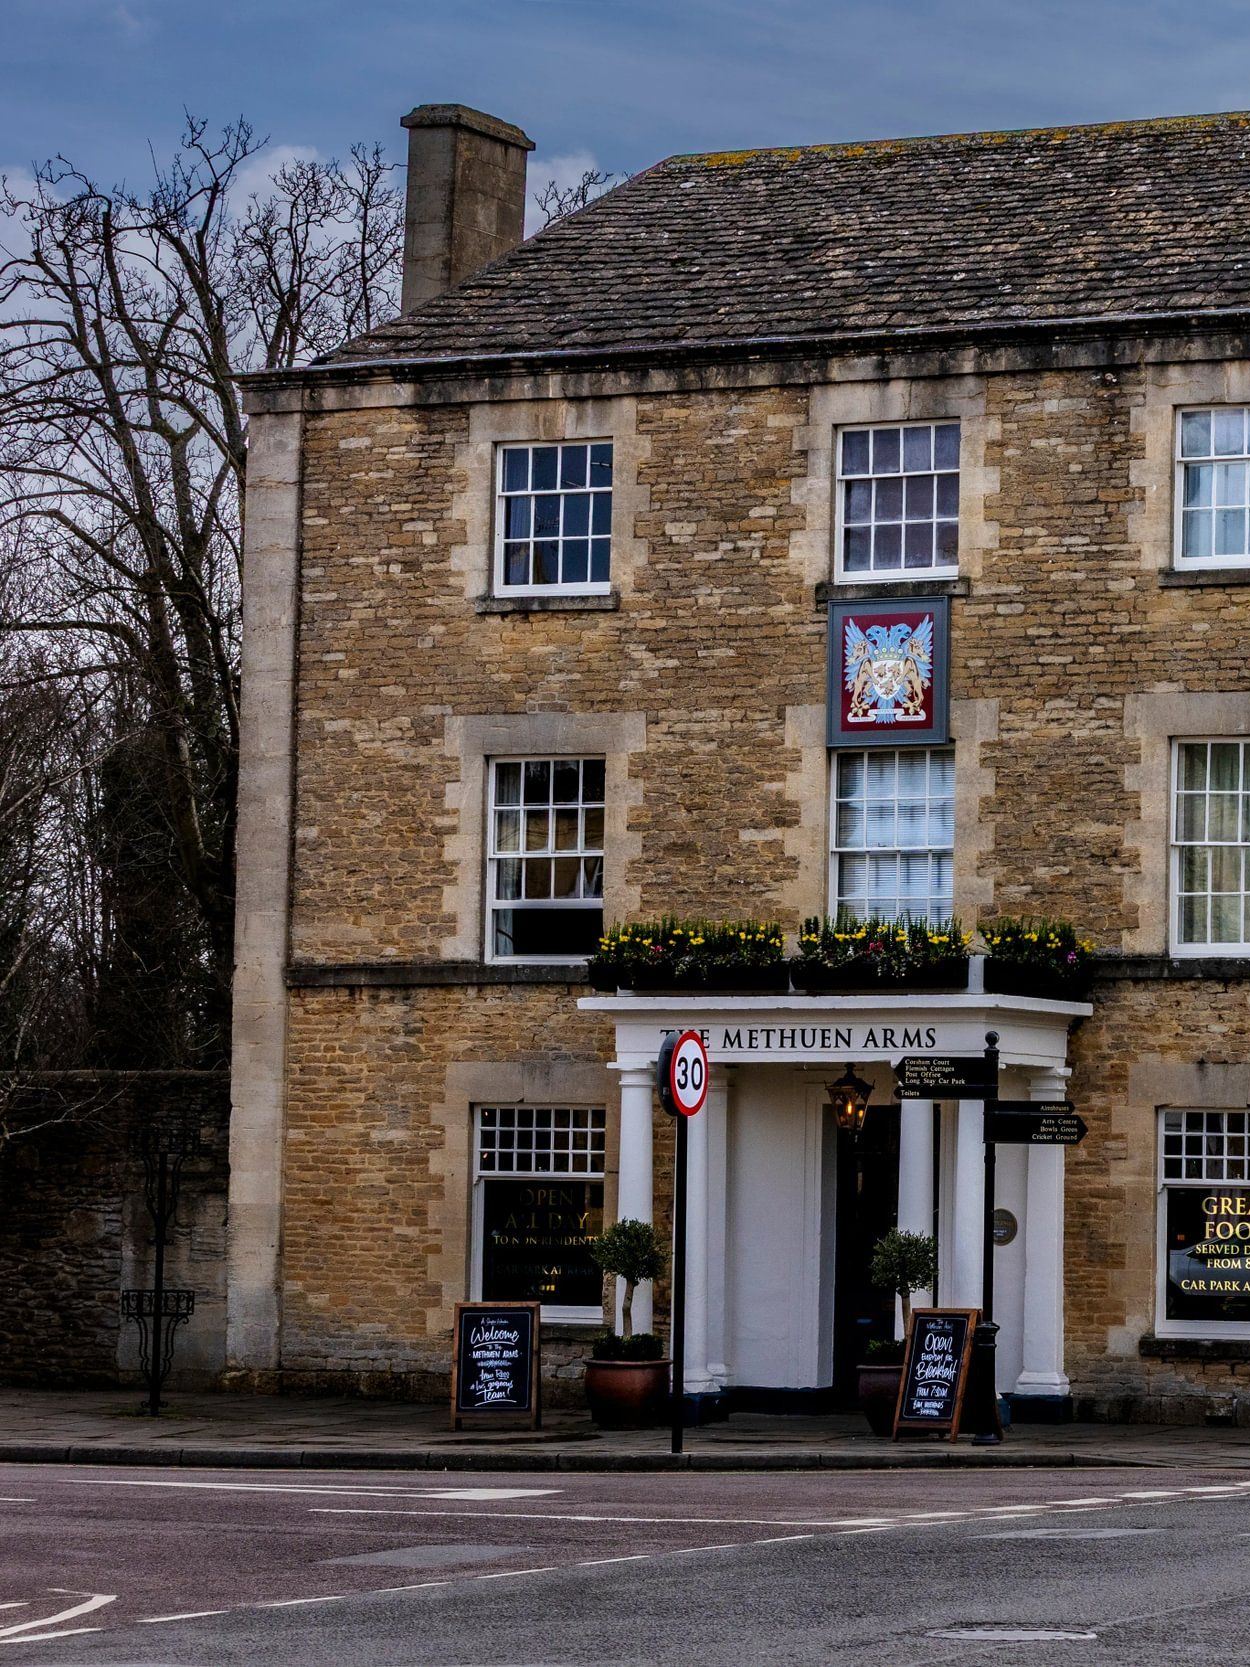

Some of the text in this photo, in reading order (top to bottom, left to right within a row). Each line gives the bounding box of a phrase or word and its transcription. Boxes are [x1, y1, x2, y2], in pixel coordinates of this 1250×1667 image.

[722, 1028, 853, 1049] METHUEN
[862, 1027, 937, 1049] ARMS
[676, 1056, 704, 1091] 30
[930, 1065, 955, 1073] Cottages
[904, 1077, 921, 1085] Long
[923, 1077, 936, 1086] Stay
[1031, 1133, 1078, 1141] Cricket Ground
[494, 1235, 509, 1245] TO
[1195, 1244, 1240, 1255] SERVED
[1207, 1258, 1242, 1270] FROM
[1181, 1279, 1206, 1290] CAR
[1210, 1280, 1240, 1291] PARK
[471, 1326, 519, 1345] Welcome
[925, 1333, 952, 1355] Open
[915, 1360, 957, 1382] Breakfast
